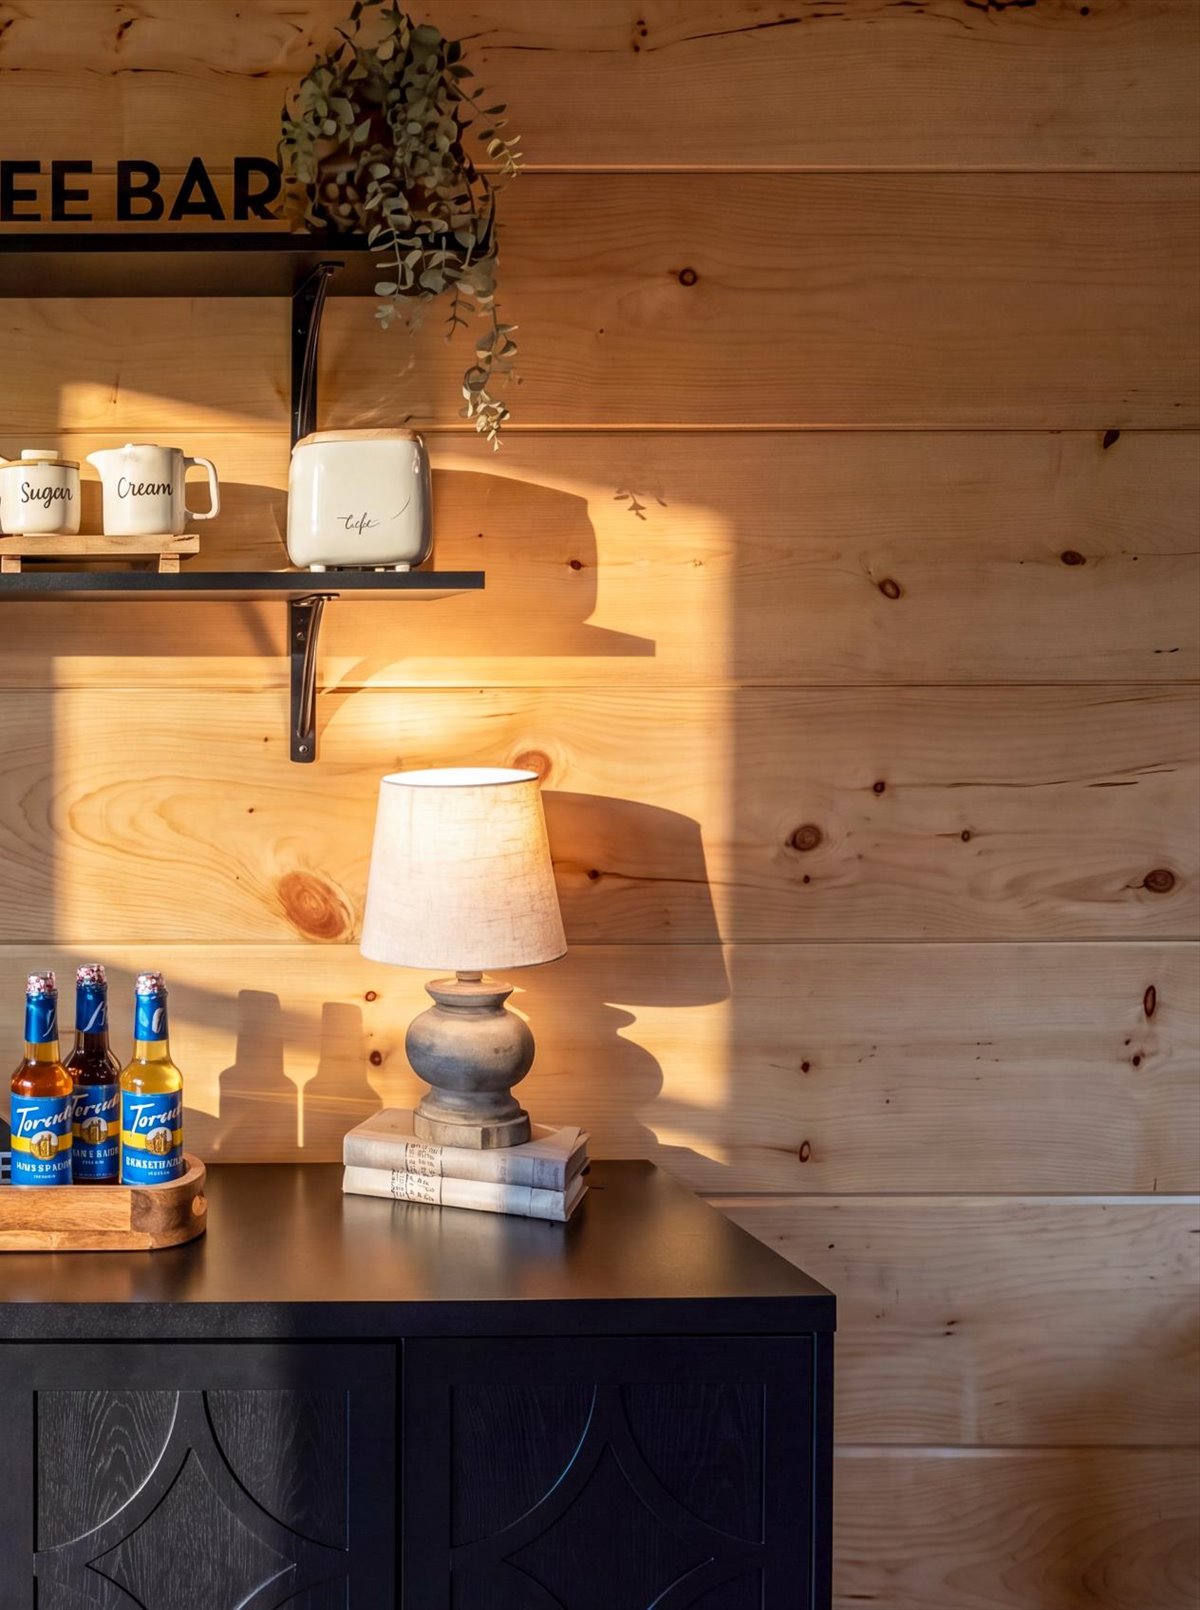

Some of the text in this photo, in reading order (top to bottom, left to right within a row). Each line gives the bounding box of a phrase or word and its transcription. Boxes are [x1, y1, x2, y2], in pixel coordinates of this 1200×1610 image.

[117, 157, 281, 222] BAR
[21, 481, 73, 509] Sugar
[117, 476, 173, 499] Cream
